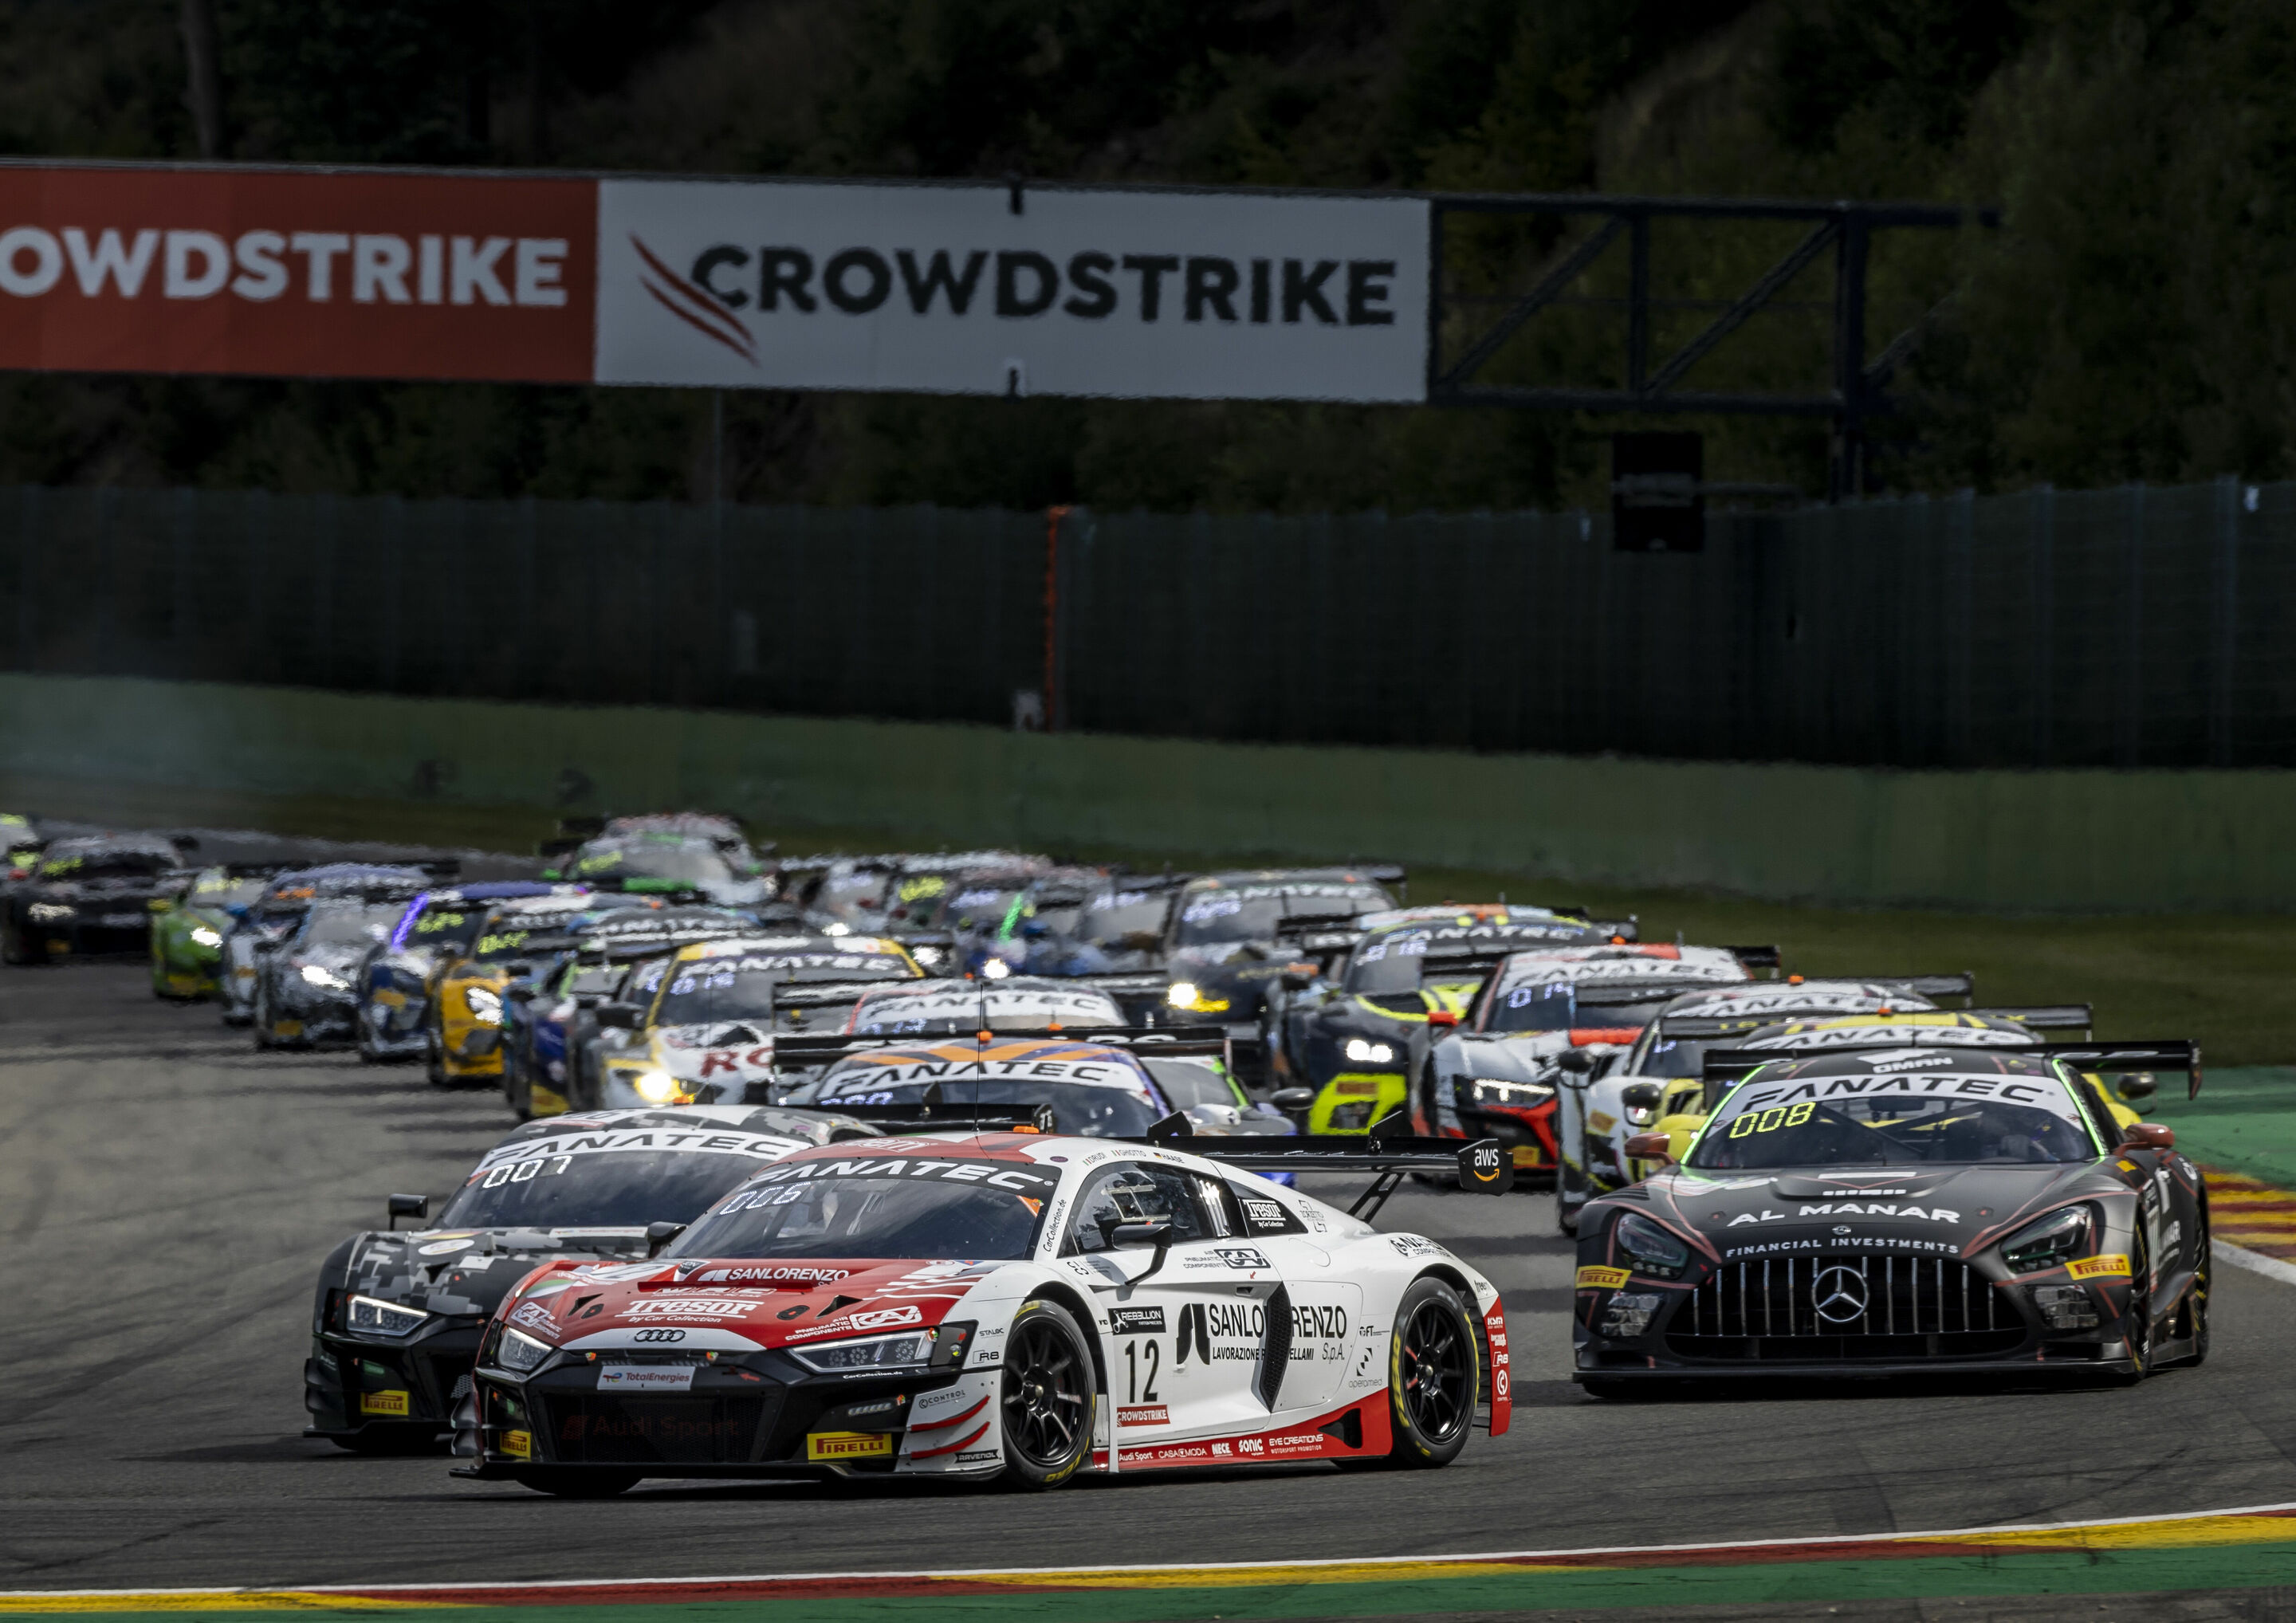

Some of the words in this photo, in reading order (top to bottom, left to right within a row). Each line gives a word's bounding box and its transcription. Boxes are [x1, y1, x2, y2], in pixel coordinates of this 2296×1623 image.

[691, 244, 1397, 324] CROWDSTRIKE
[1873, 1056, 1953, 1074] OMAN
[832, 1060, 1111, 1098] FANATEC
[1741, 1076, 2047, 1113] FANATEC
[1728, 1102, 1816, 1139] 008
[482, 1134, 792, 1169] FANATEC
[1474, 1148, 1499, 1167] aws
[482, 1155, 572, 1189] 007
[737, 1160, 1044, 1190] FANATEC
[1244, 1201, 1282, 1218] Tresor
[1726, 1210, 1786, 1227] AL
[1798, 1203, 1960, 1224] MANAR
[1726, 1239, 1822, 1258] FINANCIAL
[1830, 1237, 1960, 1255] INVESTMENTS
[729, 1267, 850, 1282] SANLORENZO
[2074, 1258, 2126, 1275] PIRELLI
[625, 1299, 758, 1315] Tresor
[784, 1326, 853, 1341] COMPONENTS
[794, 1320, 851, 1334] PNEUMATIC
[979, 1351, 1000, 1362] R8
[1212, 1346, 1260, 1361] LAVORAZIONE
[625, 1372, 691, 1384] TotalEnergies
[1125, 1339, 1160, 1404] 12
[364, 1393, 403, 1410] PIRELLI
[928, 1389, 966, 1405] CONTROL
[1116, 1409, 1168, 1423] CROWDSTRIKE
[501, 1432, 527, 1452] PIRELLI
[816, 1434, 884, 1455] PIRELLI
[1269, 1438, 1284, 1447] EYE
[958, 1452, 997, 1462] RAVENOL
[1119, 1452, 1134, 1461] Audi
[1134, 1450, 1153, 1461] Sport
